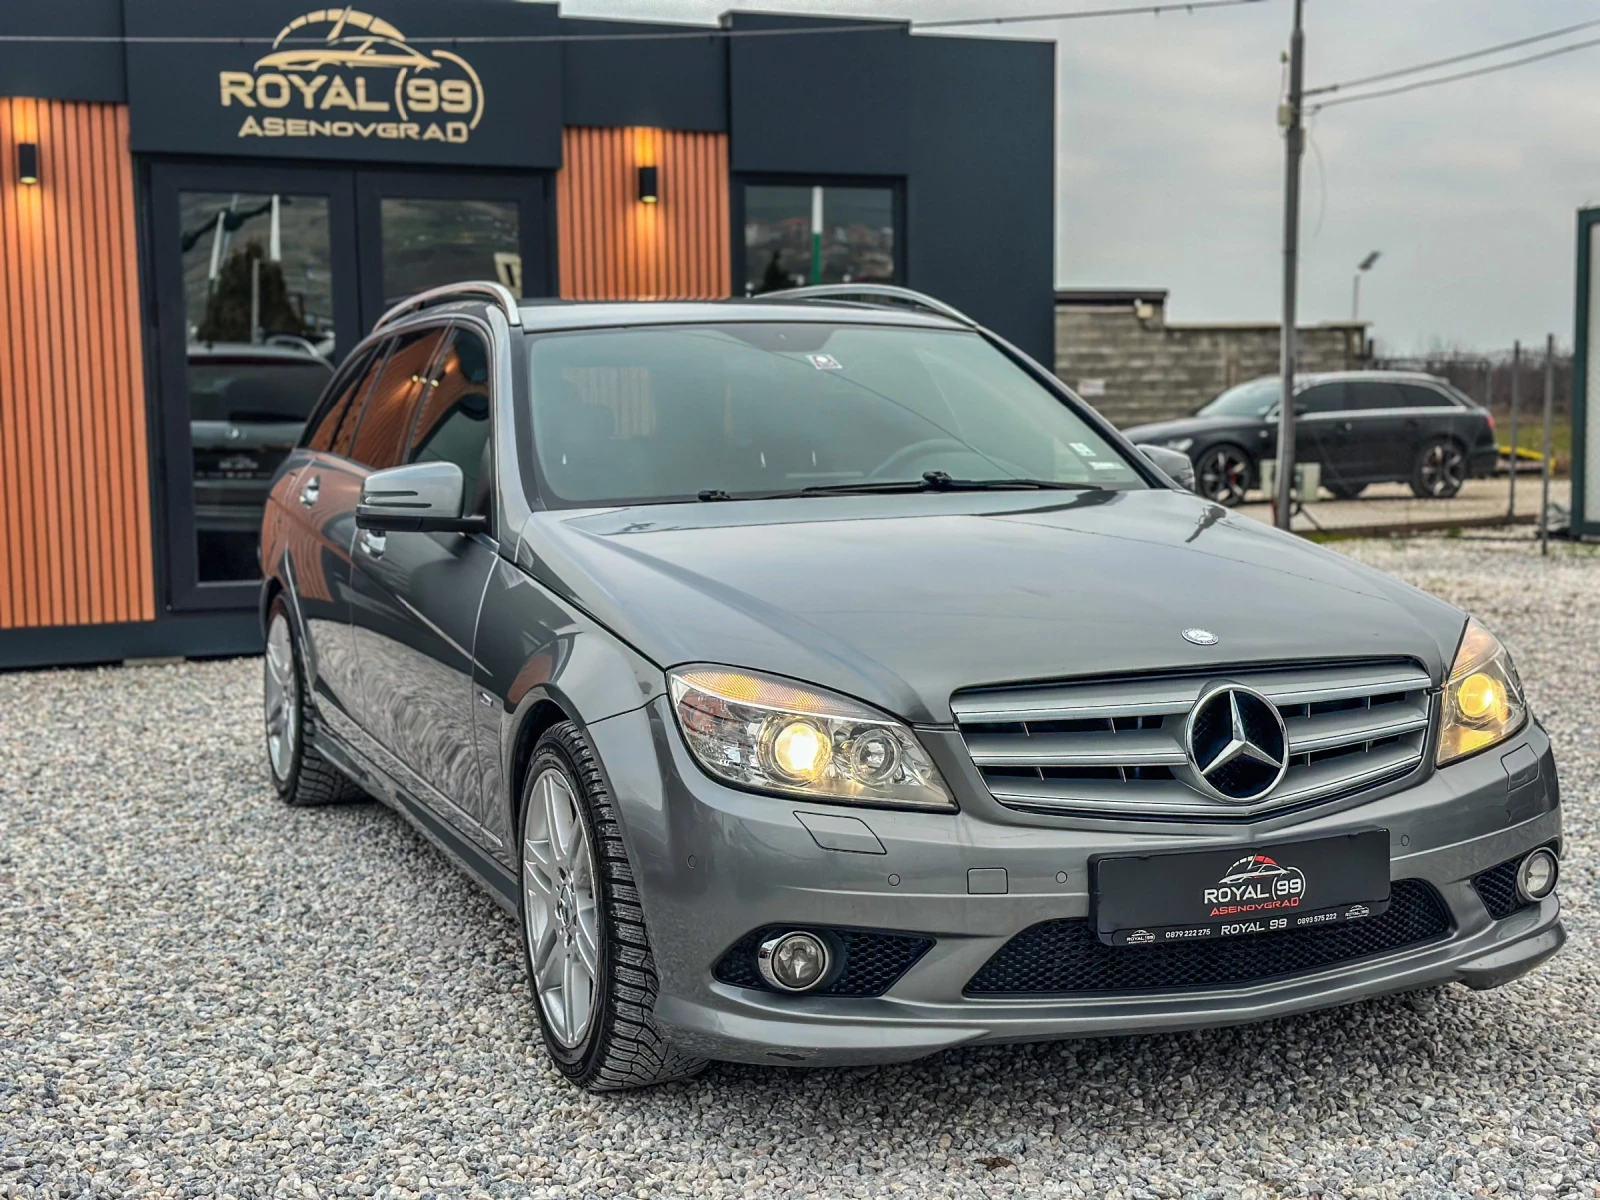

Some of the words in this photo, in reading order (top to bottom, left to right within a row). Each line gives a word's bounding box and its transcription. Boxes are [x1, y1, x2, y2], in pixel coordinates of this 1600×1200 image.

[219, 71, 390, 111] ROYAL
[238, 115, 468, 143] ASENOVGRAD
[1204, 884, 1270, 904] ROYAL
[1210, 897, 1300, 917] ASENOVGRAD
[1221, 922, 1265, 936] ROYAL
[1269, 918, 1288, 930] 99
[1297, 916, 1313, 925] 0893
[1313, 914, 1326, 923] 575
[1325, 912, 1337, 921] 222
[1165, 931, 1184, 939] 0879
[1184, 929, 1198, 937] 222
[1198, 928, 1211, 936] 275
